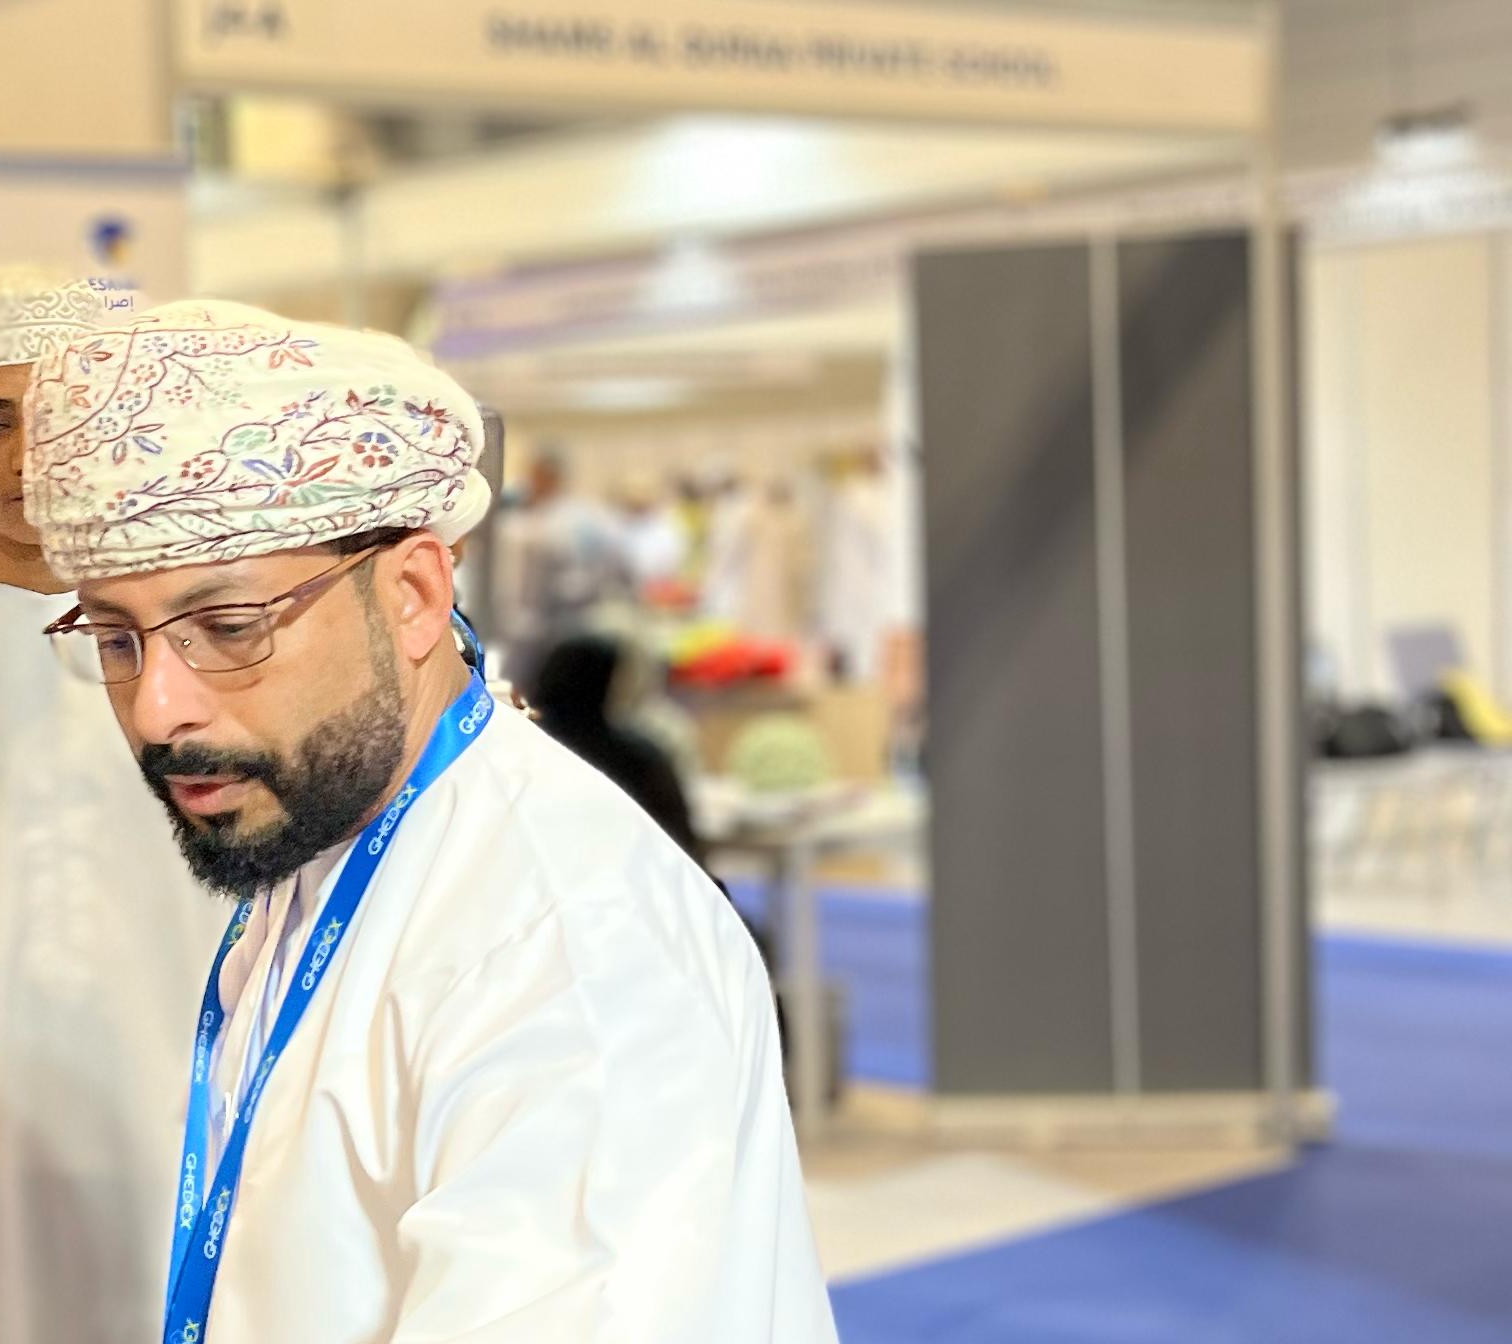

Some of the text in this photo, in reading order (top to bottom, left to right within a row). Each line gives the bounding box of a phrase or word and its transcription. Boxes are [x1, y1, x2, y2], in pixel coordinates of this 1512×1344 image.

[367, 783, 418, 856] GHEDEX
[301, 915, 345, 990] GHEDEX
[180, 1152, 198, 1231] GHEDEX
[204, 1184, 232, 1260] GHEDEX
